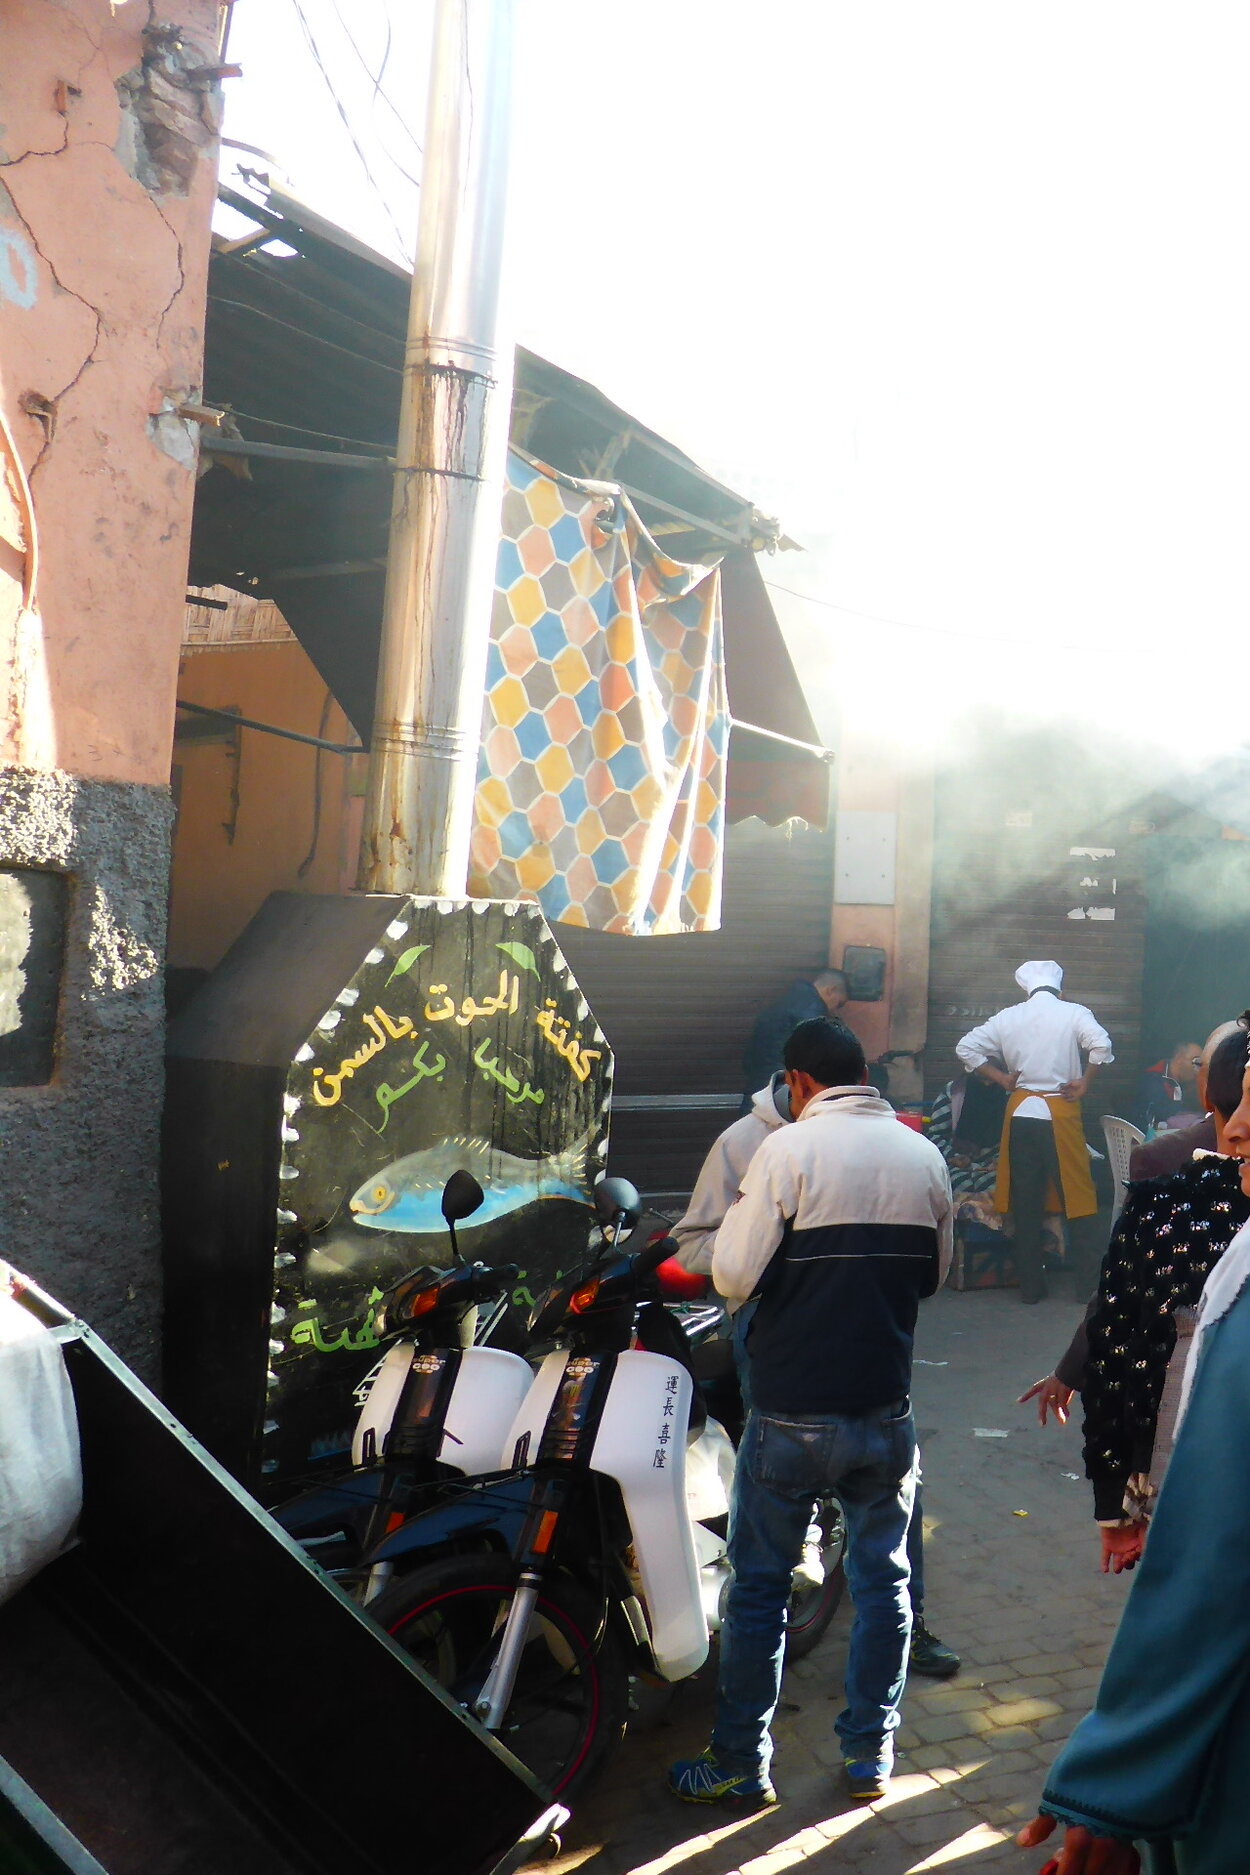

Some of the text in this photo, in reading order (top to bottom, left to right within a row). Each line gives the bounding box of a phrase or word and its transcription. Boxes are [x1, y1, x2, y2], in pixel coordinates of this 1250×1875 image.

[424, 969, 520, 1026] الحوت
[474, 1037, 545, 1104] مرحبا
[536, 997, 602, 1082] كفتة
